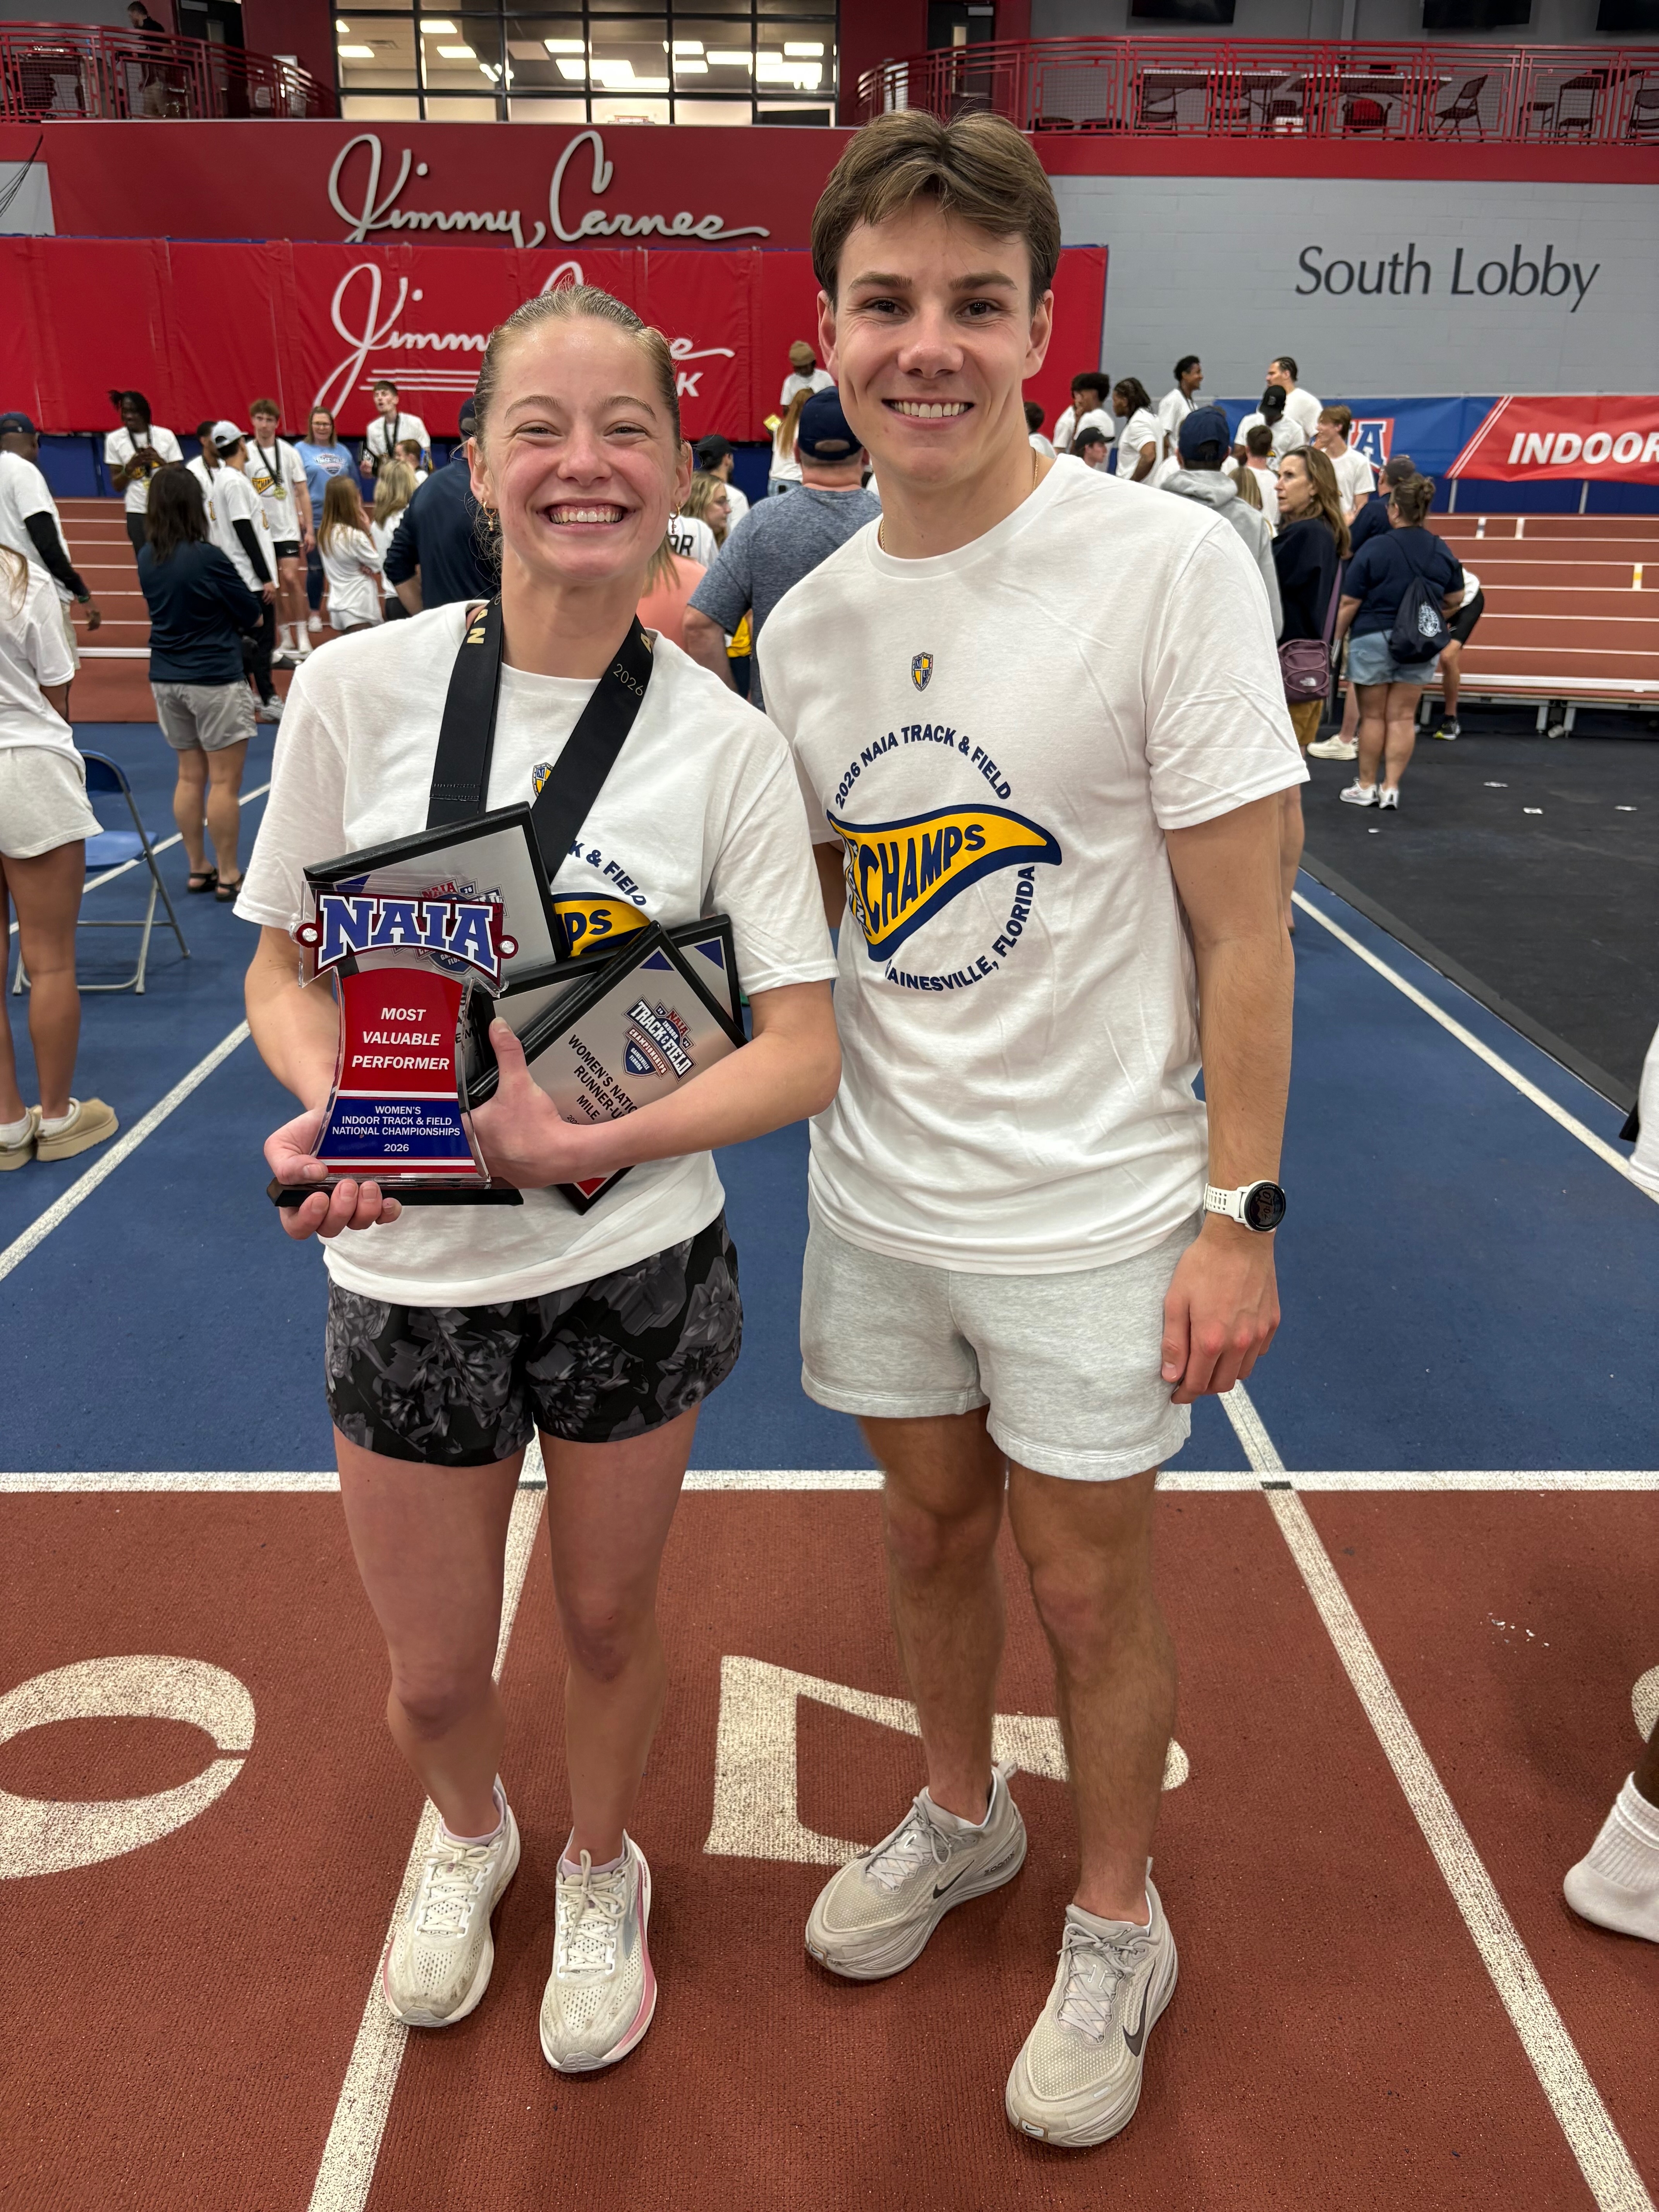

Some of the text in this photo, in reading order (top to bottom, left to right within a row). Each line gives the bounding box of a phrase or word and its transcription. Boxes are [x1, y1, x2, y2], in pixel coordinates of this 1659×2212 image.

[1295, 243, 1601, 313] South Lobby
[313, 263, 491, 418] Jimm
[1507, 431, 1659, 464] INDOOR
[613, 664, 644, 696] 2026
[835, 724, 1011, 810] 2026 NAIA TRACK & FIELD
[586, 850, 646, 906] & FIELD
[859, 824, 986, 934] CHAMPS
[991, 866, 1035, 957] FLORIDA
[318, 895, 498, 978] NAIA
[381, 1008, 426, 1021] MOST
[666, 1010, 688, 1037] NAIA
[363, 1031, 441, 1046] VALUABLE
[630, 1001, 667, 1041] TRACK
[662, 1039, 692, 1075] FIELD
[663, 1020, 678, 1040] INDOOR
[352, 1055, 450, 1070] PERFORMER
[629, 1029, 666, 1073] CHAMPIONSHIPS
[629, 1055, 643, 1071] FLORIDA
[630, 1048, 650, 1070] GAINESVILLE
[568, 1034, 638, 1114] WOMEN'S NATIO
[574, 1065, 625, 1119] RUNNER-U
[342, 1116, 380, 1124] INDOOR
[383, 1117, 413, 1125] TRACK
[426, 1117, 452, 1125] FIELD
[375, 1106, 421, 1114] WOMEN'S
[567, 1115, 580, 1125] 202
[576, 1095, 600, 1120] MILE
[332, 1127, 460, 1136] NATIONAL CHAMPIONSHIPS
[384, 1144, 409, 1152] 2026
